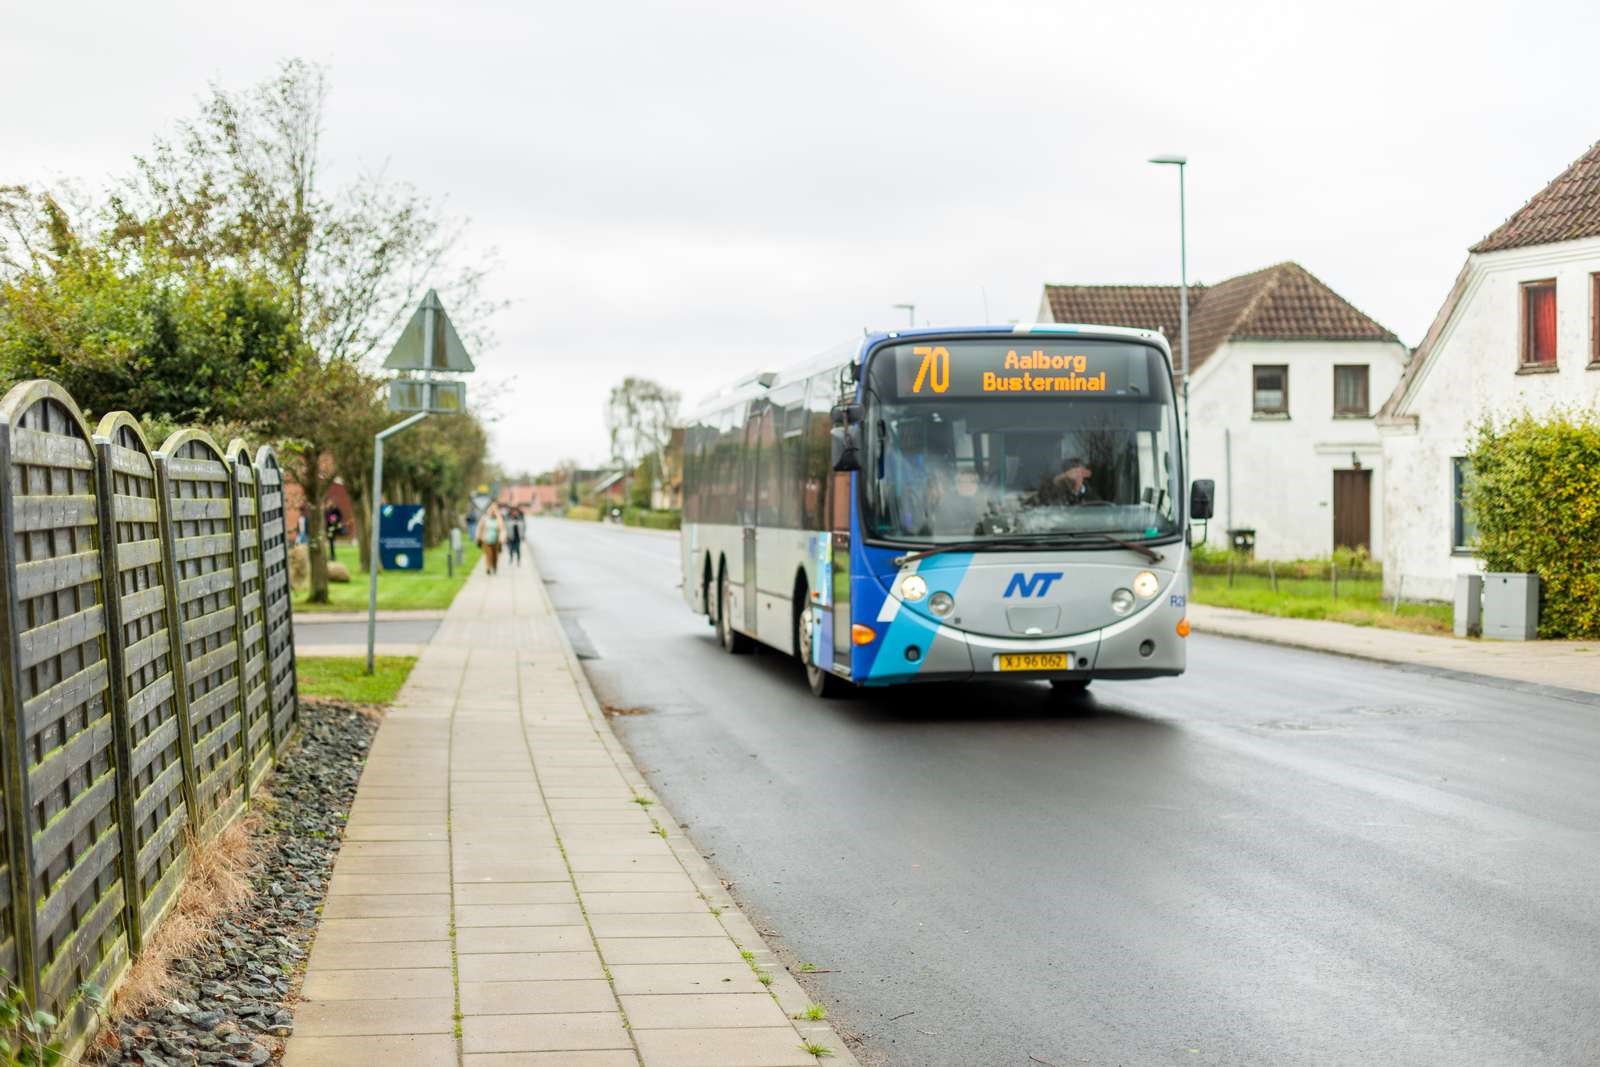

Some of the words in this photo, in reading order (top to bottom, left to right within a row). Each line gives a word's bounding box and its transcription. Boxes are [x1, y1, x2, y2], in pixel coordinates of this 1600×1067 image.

[912, 347, 950, 393] 70
[1004, 350, 1087, 372] Aalborg
[983, 371, 1106, 392] Busterminal
[1003, 572, 1064, 598] NT
[1023, 656, 1038, 668] 96
